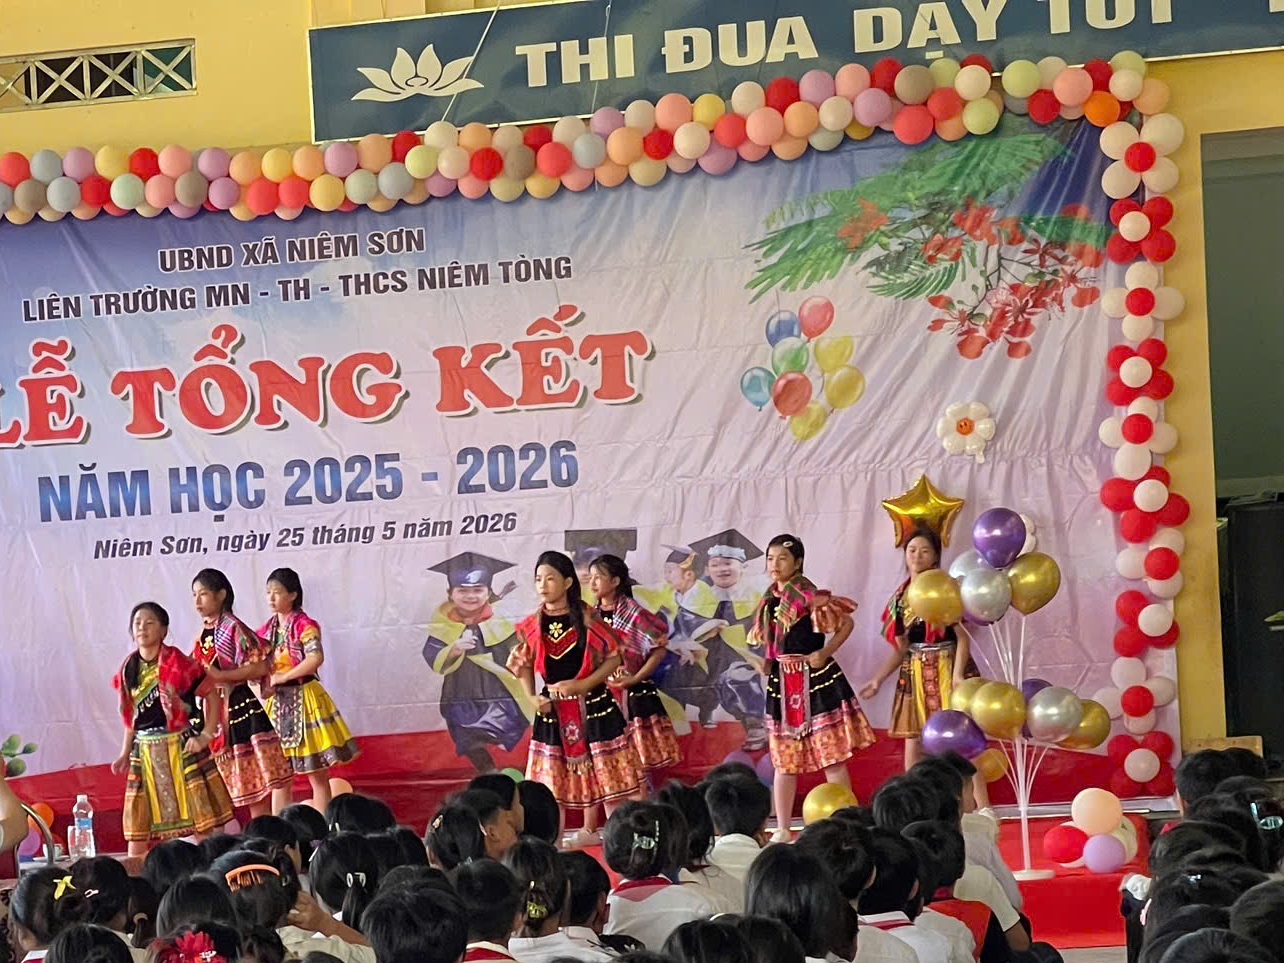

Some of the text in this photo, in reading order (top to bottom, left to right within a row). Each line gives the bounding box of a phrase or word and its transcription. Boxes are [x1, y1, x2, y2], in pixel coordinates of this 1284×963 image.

[515, 34, 635, 88] THI
[661, 15, 819, 74] ĐUA
[853, 0, 1007, 60] DẠY
[23, 293, 82, 322] LIÊN
[90, 285, 196, 317] TRƯỜNG
[205, 283, 251, 308] MN
[278, 278, 311, 302] TH
[338, 270, 408, 297] THCS
[418, 261, 490, 291] NIÊM
[498, 255, 572, 284] TÒNG
[159, 229, 425, 273] UBND XÃ NIÊM SƠN
[110, 323, 404, 435] TỔNG
[431, 303, 650, 414] KẾT
[37, 440, 579, 523] NĂM HỌC 2025 - 2026
[94, 512, 517, 559] Niêm Sơn, ngày 25 tháng 5 năm 2026
